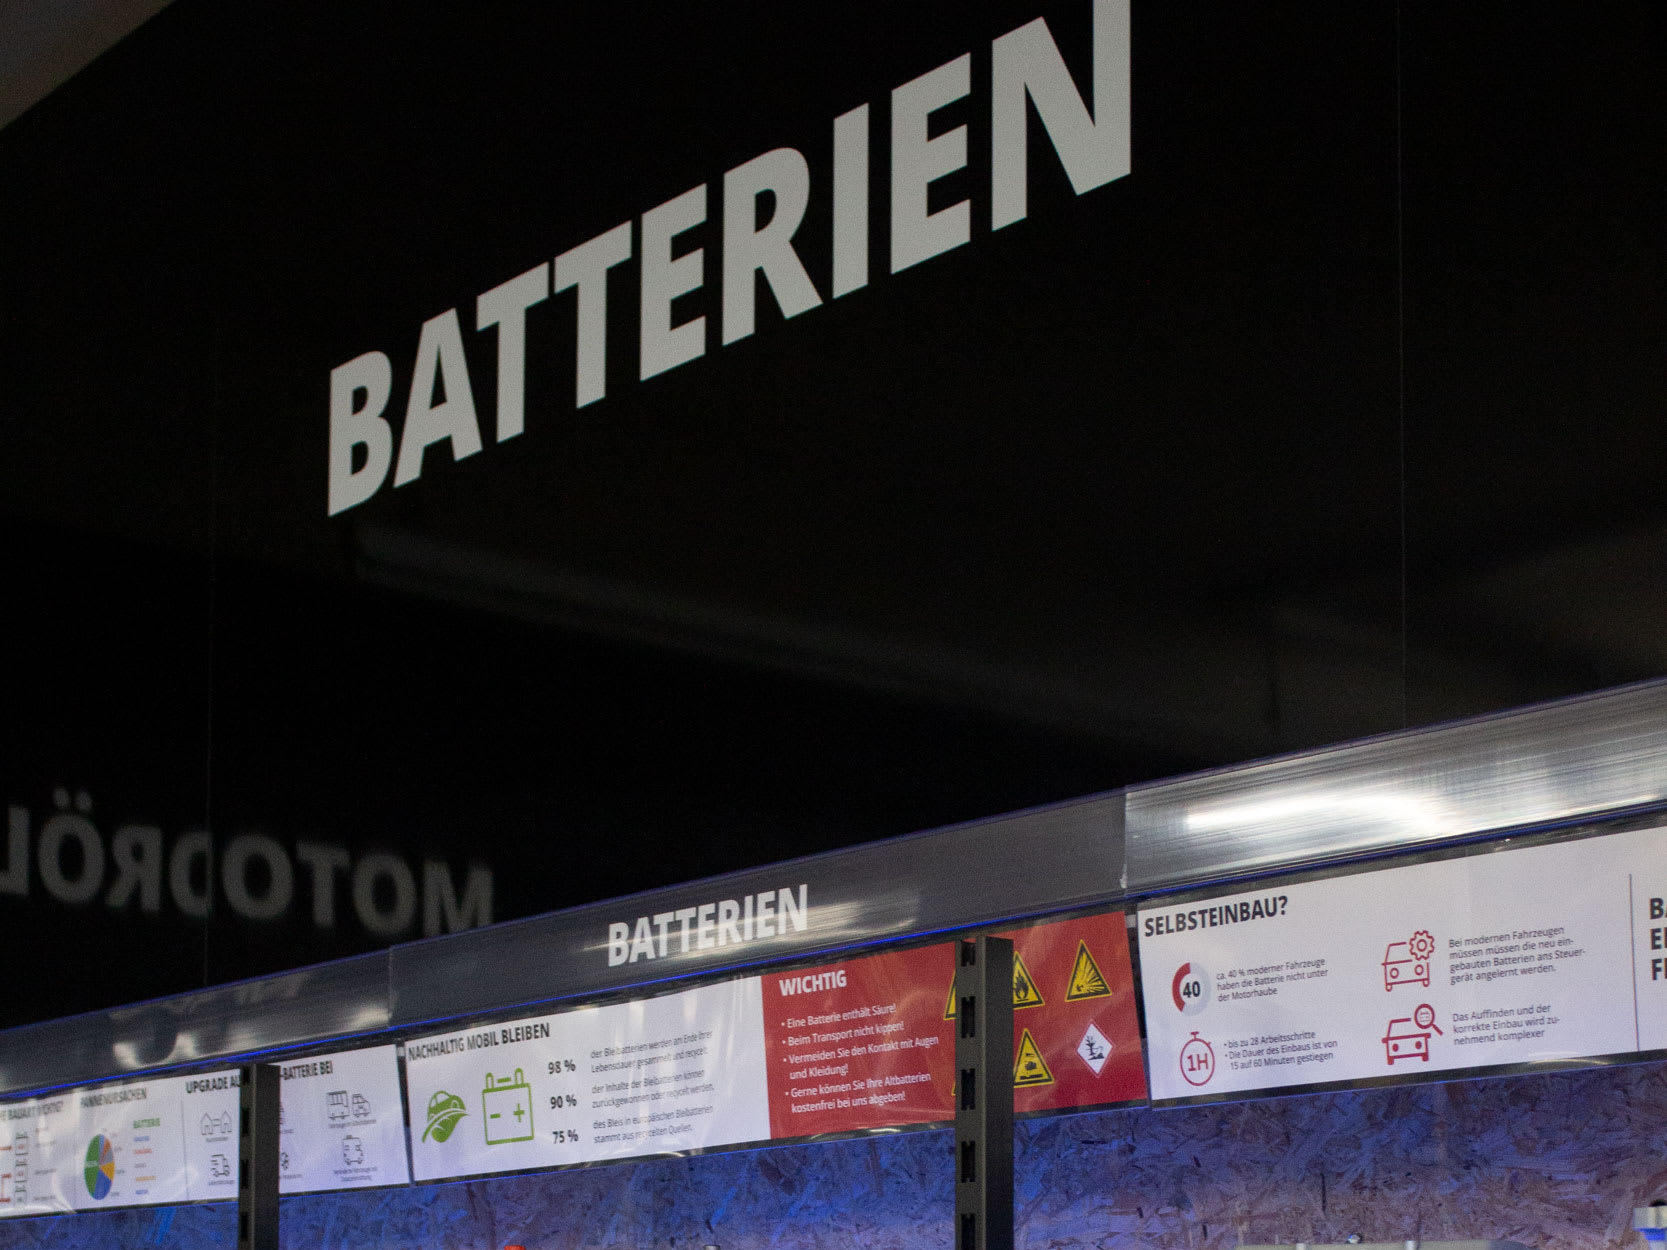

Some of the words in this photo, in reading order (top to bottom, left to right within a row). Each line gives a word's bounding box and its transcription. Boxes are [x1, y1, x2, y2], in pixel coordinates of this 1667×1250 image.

[328, 0, 1131, 517] BATTERIEN
[608, 884, 808, 967] BATTERIEN
[1145, 896, 1288, 937] SELBSTEINBAU?
[1449, 938, 1462, 948] Bei
[1464, 933, 1510, 946] modernen
[1512, 926, 1564, 940] Fahrzeugen
[1450, 948, 1483, 960] müssen
[1485, 944, 1520, 957] müssen
[1522, 942, 1536, 953] die
[1539, 940, 1555, 950] neu
[1557, 937, 1574, 948] ein-
[1229, 969, 1237, 978] 40
[1247, 963, 1283, 976] moderner
[1285, 958, 1325, 972] Fahrzeuge
[1450, 960, 1491, 973] gebauten
[1493, 954, 1535, 968] Batterien
[1538, 952, 1553, 962] ans
[1555, 947, 1585, 959] Steuer-
[780, 970, 847, 996] WICHTIG
[1217, 980, 1239, 991] haben
[1241, 978, 1252, 987] die
[1254, 975, 1284, 986] Batterie
[1286, 972, 1306, 983] nicht
[1308, 969, 1328, 980] unter
[1451, 973, 1473, 985] gerät
[1476, 968, 1518, 982] angelernt
[1520, 963, 1556, 975] werden.
[1183, 981, 1200, 998] 40
[1218, 992, 1230, 1002] der
[1232, 987, 1277, 1000] Motorhaube
[787, 1017, 806, 1028] Eine
[808, 1012, 841, 1026] Batterie
[842, 1007, 870, 1021] enthält
[872, 1003, 896, 1015] Säure!
[1453, 1012, 1469, 1022] Das
[1470, 1007, 1514, 1021] Auffinden
[1517, 1005, 1534, 1016] und
[1536, 1003, 1551, 1014] der
[788, 1035, 810, 1046] Beim
[812, 1029, 853, 1044] Transport
[855, 1026, 873, 1036] nicht
[876, 1021, 904, 1035] kippen!
[1453, 1022, 1491, 1033] korrekte
[1493, 1018, 1523, 1030] Einbau
[1525, 1015, 1544, 1027] wird
[1547, 1016, 1560, 1025] zu-
[409, 1038, 464, 1060] NACHHALTIG
[467, 1031, 499, 1051] MOBIL
[502, 1022, 550, 1043] BLEIBEN
[1229, 1039, 1239, 1049] bis
[1241, 1039, 1248, 1047] zu
[1250, 1037, 1259, 1046] 28
[1261, 1031, 1316, 1044] Arbeitsschritte
[1454, 1033, 1495, 1045] nehmend
[1498, 1028, 1544, 1043] komplexer
[789, 1051, 835, 1064] Vermeiden
[837, 1048, 850, 1058] Sie
[851, 1044, 866, 1055] den
[868, 1040, 899, 1053] Kontakt
[900, 1038, 913, 1048] mit
[915, 1036, 938, 1048] Augen
[1229, 1050, 1240, 1059] Die
[1242, 1048, 1265, 1058] Dauer
[1267, 1046, 1279, 1055] des
[1281, 1043, 1310, 1054] Einbaus
[1312, 1041, 1321, 1050] ist
[1323, 1040, 1338, 1049] von
[548, 1061, 561, 1074] 98
[565, 1060, 576, 1072] %
[1187, 1053, 1208, 1071] 1H
[1231, 1061, 1239, 1070] 15
[1241, 1060, 1252, 1069] auf
[1253, 1058, 1262, 1067] 60
[1264, 1055, 1295, 1067] Minuten
[1297, 1051, 1333, 1065] gestiegen
[186, 1077, 228, 1093] UPGRADE
[320, 1061, 333, 1074] BEI
[790, 1069, 807, 1079] und
[809, 1064, 848, 1077] Kleidung!
[791, 1086, 817, 1097] Gerne
[819, 1081, 851, 1094] können
[853, 1078, 865, 1089] Sie
[866, 1076, 883, 1088] Ihre
[884, 1072, 931, 1086] Altbatterien
[550, 1096, 563, 1109] 90
[566, 1095, 577, 1106] %
[792, 1099, 835, 1113] kostenfrei
[837, 1097, 850, 1108] bei
[852, 1095, 867, 1105] uns
[869, 1092, 905, 1107] abgeben!
[552, 1131, 565, 1143] 75
[568, 1130, 578, 1142] %
